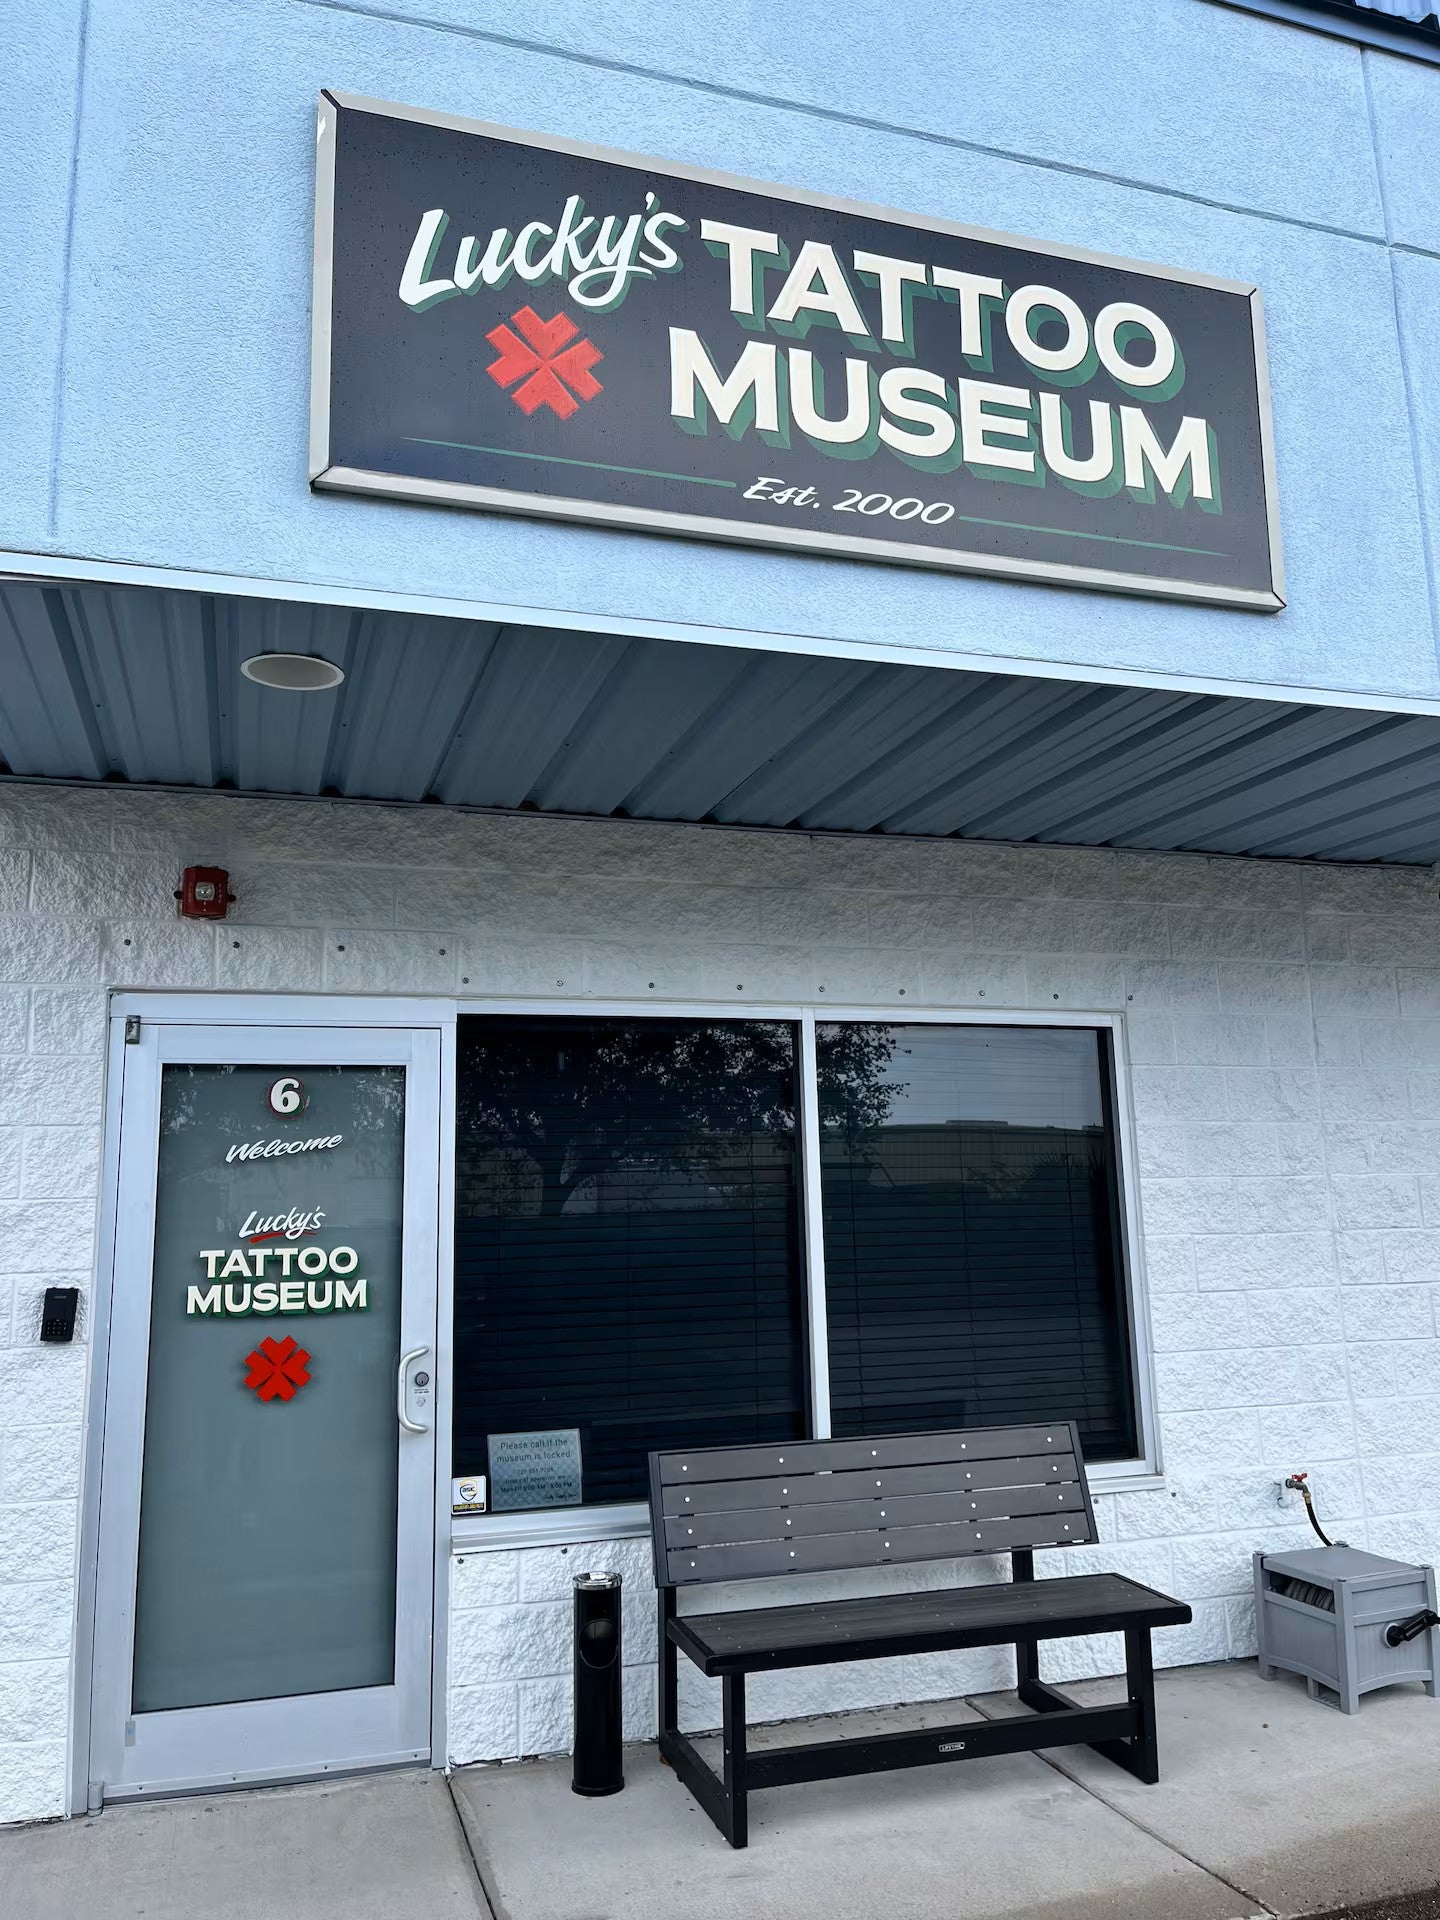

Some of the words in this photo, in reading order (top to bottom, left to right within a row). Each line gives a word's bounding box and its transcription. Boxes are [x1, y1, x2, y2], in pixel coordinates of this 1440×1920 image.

[399, 191, 687, 308] Lucky's
[700, 218, 1178, 388] TATTOO
[668, 325, 1214, 500] MUSEUM
[742, 476, 821, 509] Est.
[832, 489, 955, 525] 2000
[269, 1077, 302, 1114] 6
[225, 1134, 343, 1164] Welcome
[238, 1206, 326, 1240] Lucky's
[199, 1246, 359, 1279] TATTOO
[186, 1279, 368, 1315] MUSEUM
[496, 1454, 531, 1464] museum
[534, 1452, 542, 1460] is
[543, 1450, 571, 1460] locked
[500, 1441, 528, 1451] Please
[530, 1440, 545, 1448] call
[554, 1438, 568, 1447] the
